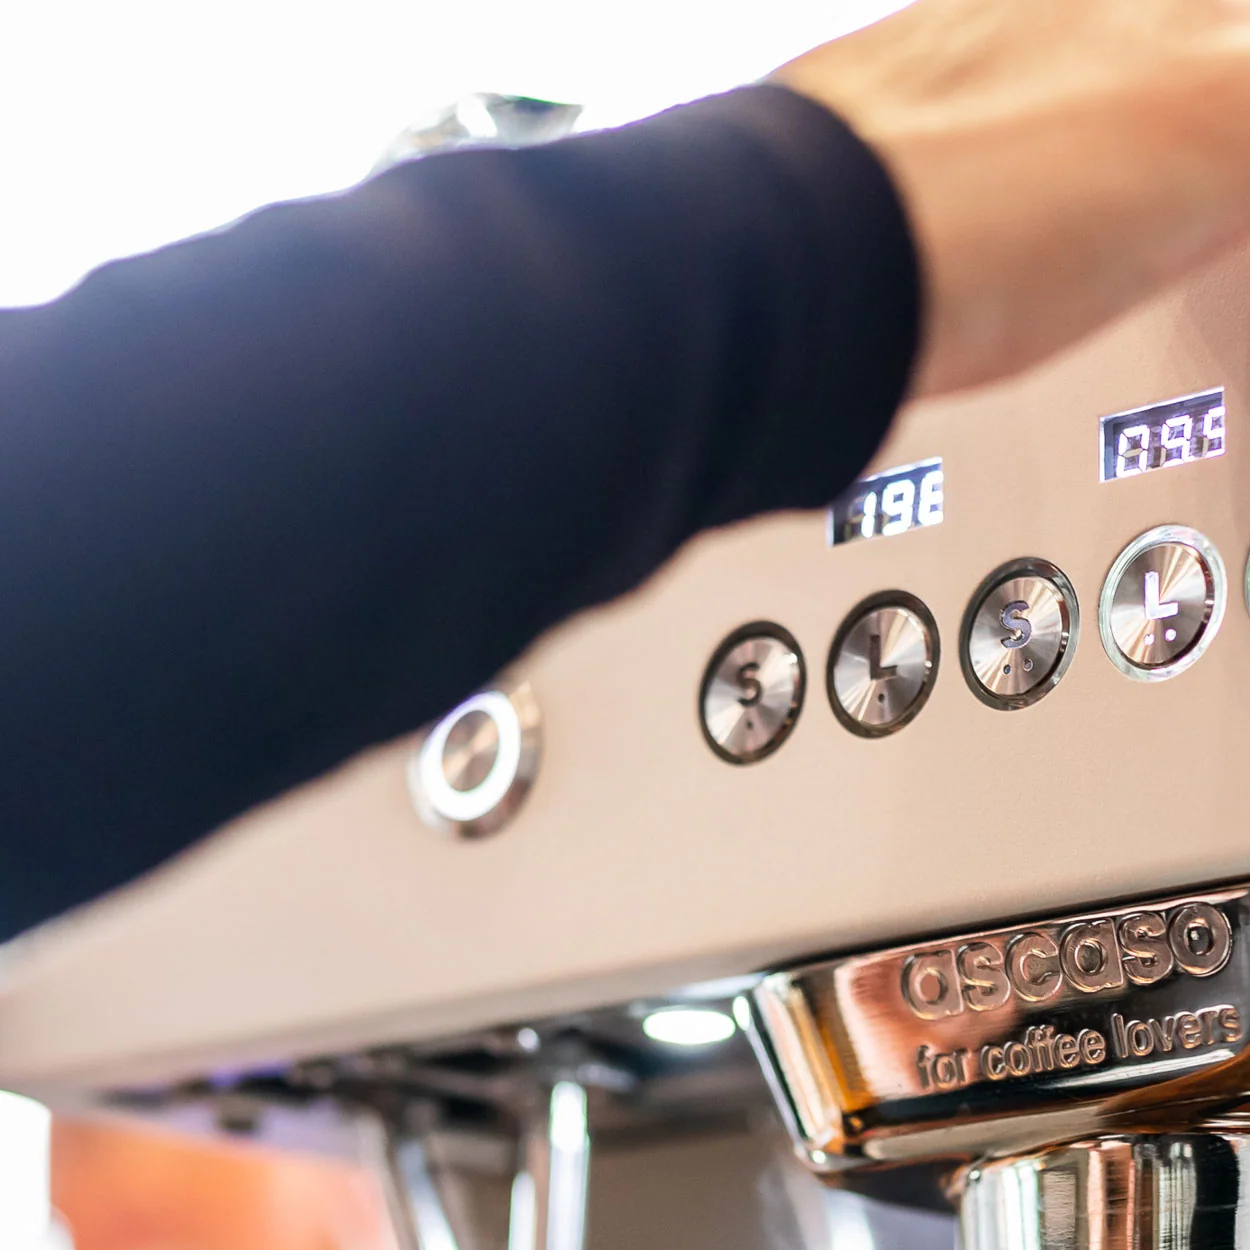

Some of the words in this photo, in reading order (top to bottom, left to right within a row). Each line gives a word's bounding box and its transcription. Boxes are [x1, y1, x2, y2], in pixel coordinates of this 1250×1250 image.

[1144, 571, 1179, 620] L
[1001, 601, 1032, 649] S
[868, 634, 898, 680] L
[738, 662, 762, 706] S
[901, 901, 1232, 1021] ascaso
[914, 1044, 971, 1091] for
[980, 1023, 1106, 1081] coffee
[1111, 1003, 1243, 1059] lovers
